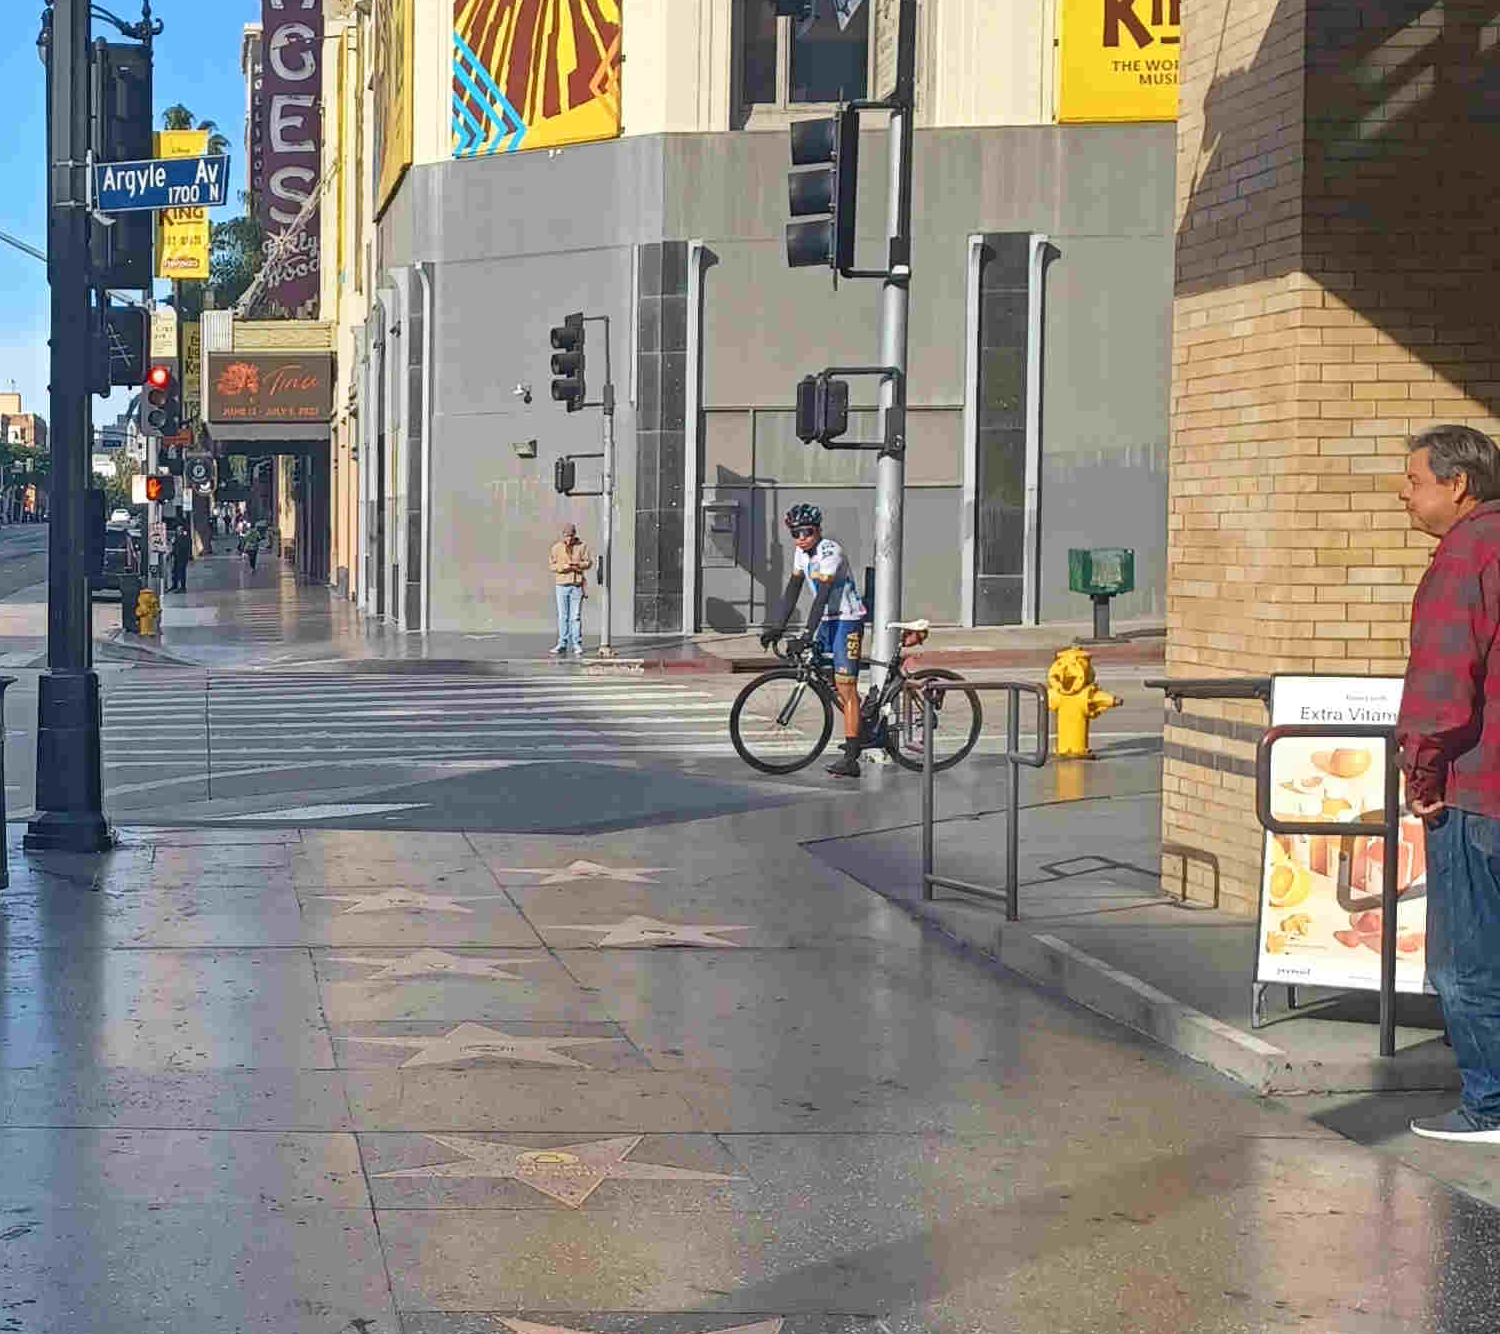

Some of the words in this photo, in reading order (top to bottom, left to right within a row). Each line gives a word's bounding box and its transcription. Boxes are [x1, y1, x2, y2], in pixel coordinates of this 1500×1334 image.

[1112, 60, 1141, 72] THE
[102, 163, 166, 198] Argyle
[195, 159, 219, 184] Av
[168, 185, 200, 204] 1700
[209, 183, 219, 201] N
[1300, 706, 1343, 722] Extra
